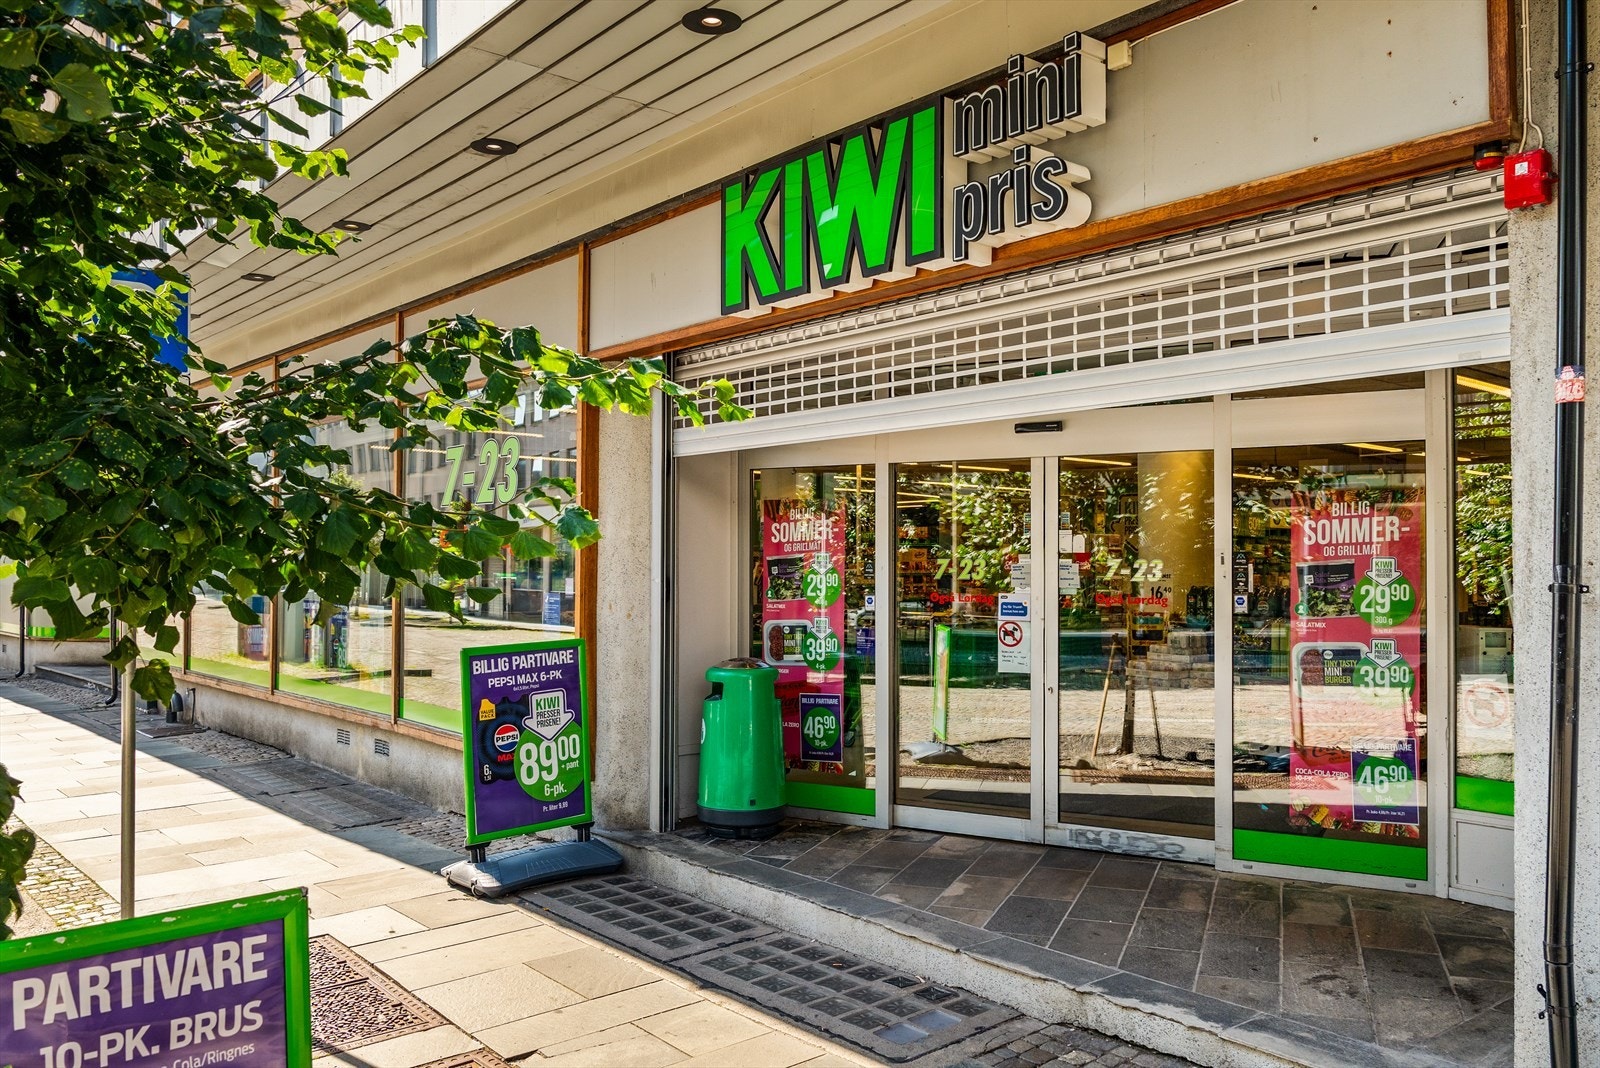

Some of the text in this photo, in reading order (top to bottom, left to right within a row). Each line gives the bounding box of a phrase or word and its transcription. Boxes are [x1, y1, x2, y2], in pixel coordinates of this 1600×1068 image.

[952, 30, 1083, 157] mini
[721, 95, 944, 316] KIWI
[952, 144, 1068, 262] pris
[441, 435, 521, 507] 7-23
[1332, 501, 1370, 516] BILLIG
[1303, 516, 1411, 545] SOMMER-
[1323, 544, 1381, 556] OG GRILLMAT
[934, 558, 987, 580] 7-23
[1103, 559, 1164, 581] 7-23
[1374, 642, 1392, 650] KIWI
[472, 650, 575, 675] BILLIG PARTIVARE
[1339, 659, 1358, 667] TASTY
[488, 669, 563, 689] PEPSI MAX 6-PK
[1324, 667, 1343, 676] MINI
[1325, 676, 1352, 684] BURGER
[536, 696, 560, 711] KIWI
[536, 709, 561, 720] PRESSER
[536, 717, 561, 728] PRISENE!
[496, 733, 519, 743] PEPSI
[566, 759, 580, 770] pant
[1295, 767, 1350, 779] COCA-COLA ZERO
[544, 781, 567, 797] 6-pk.
[12, 934, 268, 1031] PARTIVARE
[39, 1000, 264, 1068] 10-PK. BRUS
